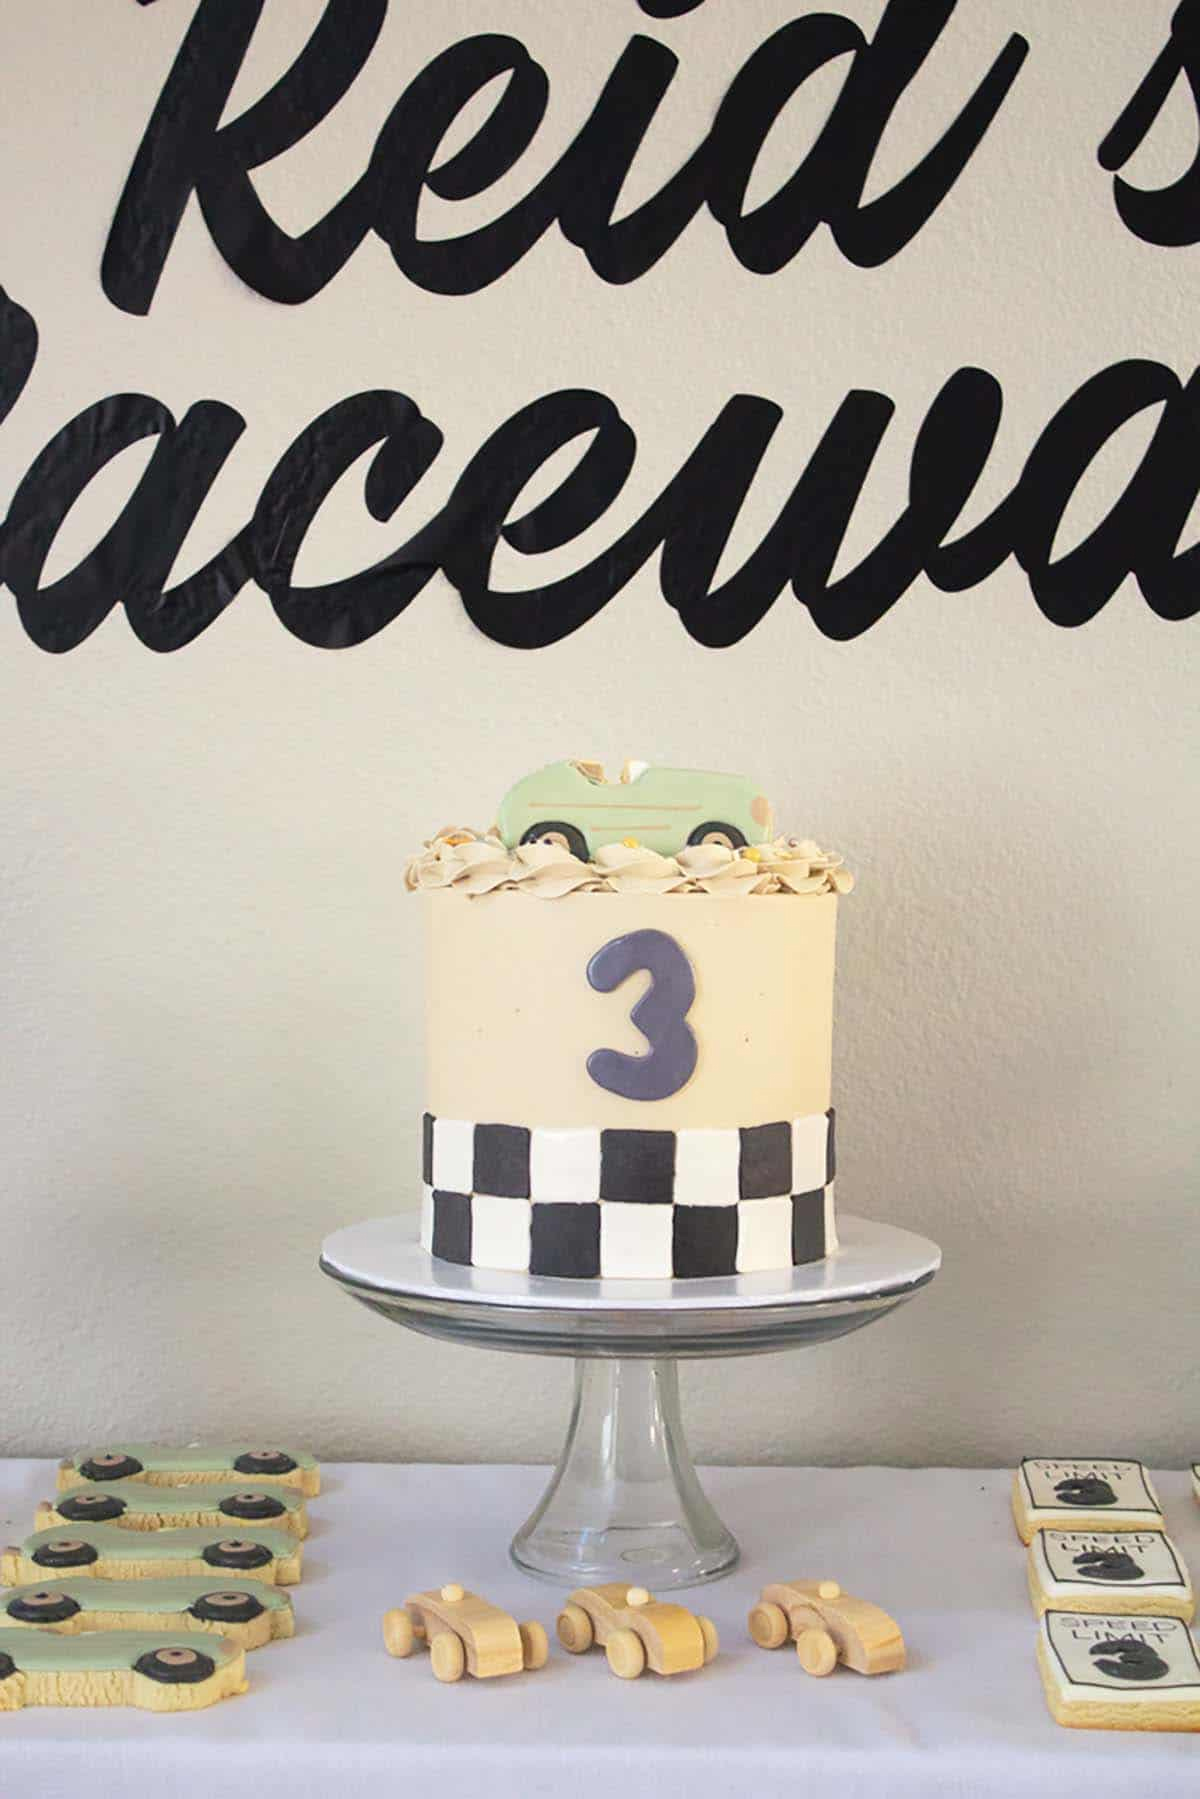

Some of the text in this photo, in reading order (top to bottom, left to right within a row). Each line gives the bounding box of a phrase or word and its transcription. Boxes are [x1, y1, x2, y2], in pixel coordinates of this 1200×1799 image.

[0, 284, 1200, 652] acewa
[586, 928, 698, 1101] 3
[1053, 1478, 1119, 1505] 3
[1049, 1532, 1156, 1543] SPEED
[1060, 1542, 1149, 1555] LIMIT
[1071, 1551, 1145, 1580] 3
[1060, 1616, 1178, 1631] SPEED
[1071, 1629, 1169, 1644] LIMIT
[1088, 1639, 1170, 1680] 3
